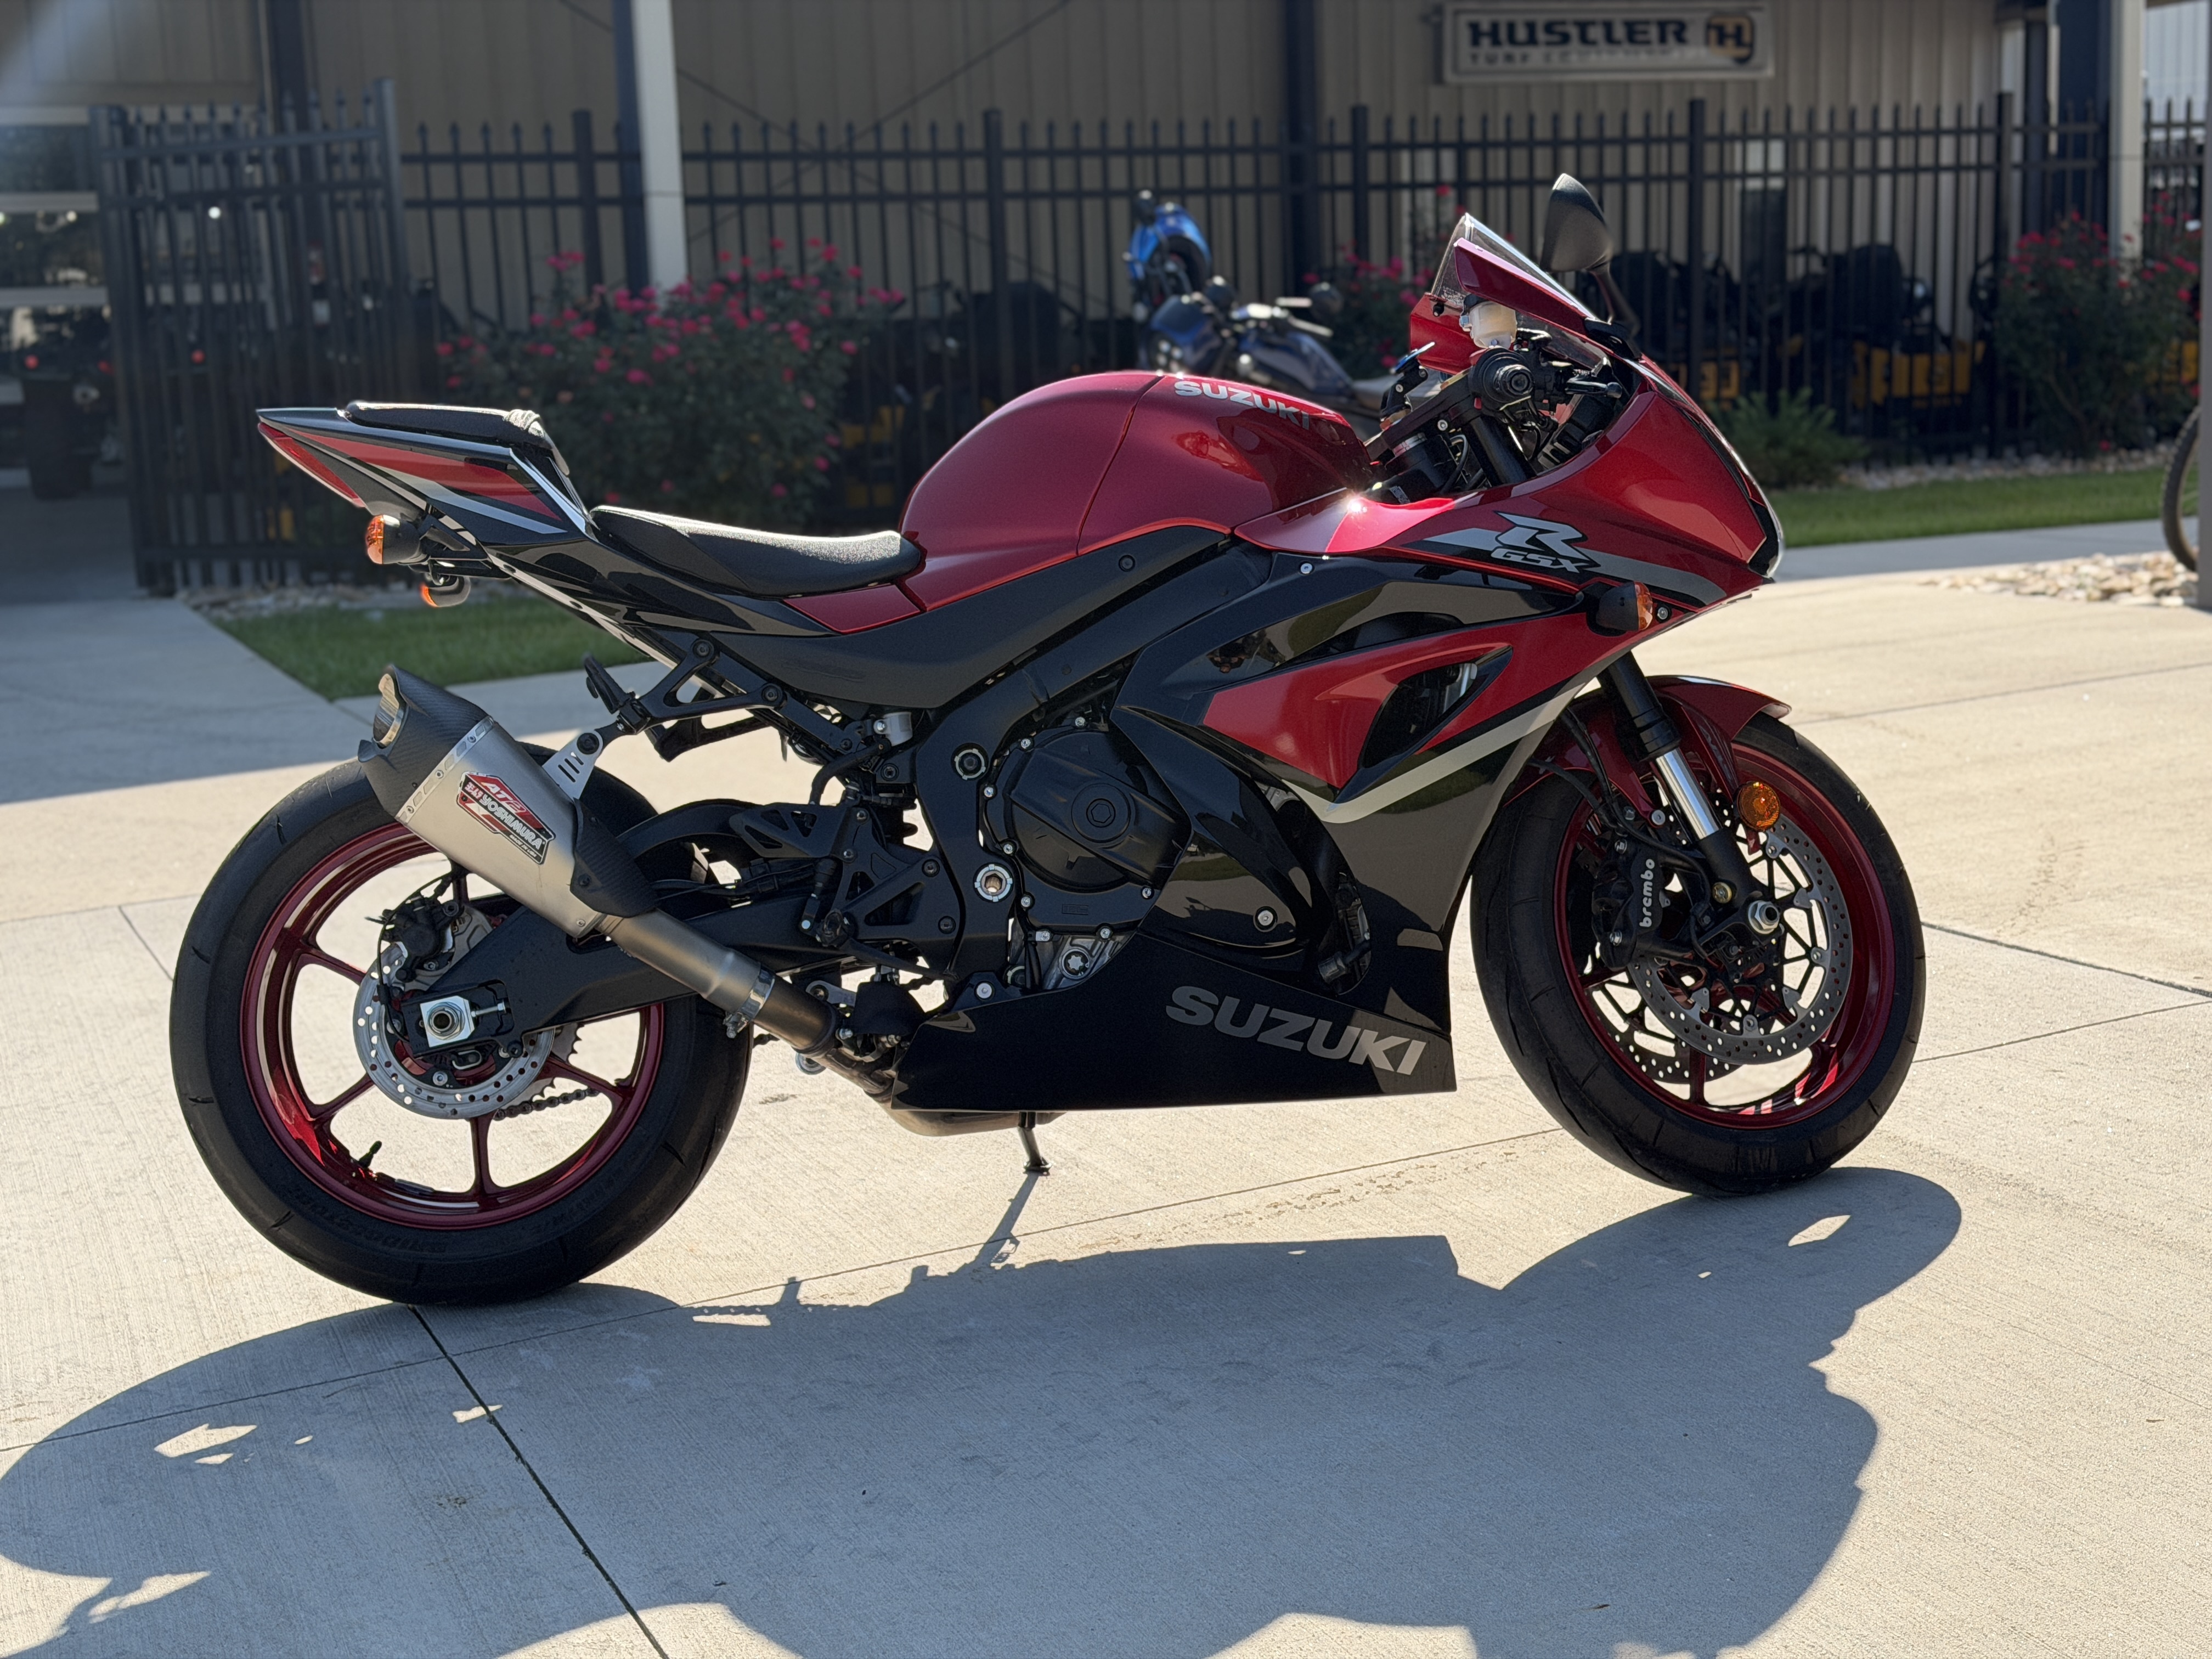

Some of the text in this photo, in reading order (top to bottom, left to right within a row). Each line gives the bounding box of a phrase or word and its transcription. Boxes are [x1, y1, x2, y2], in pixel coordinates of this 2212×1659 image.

[1466, 19, 1688, 48] HUSTLER
[1174, 381, 1310, 430] SUZUKI
[1491, 548, 1589, 573] GSX
[479, 794, 542, 850] YOSHIMURA
[1639, 859, 1655, 928] brembo
[1165, 985, 1426, 1075] SUZUKI
